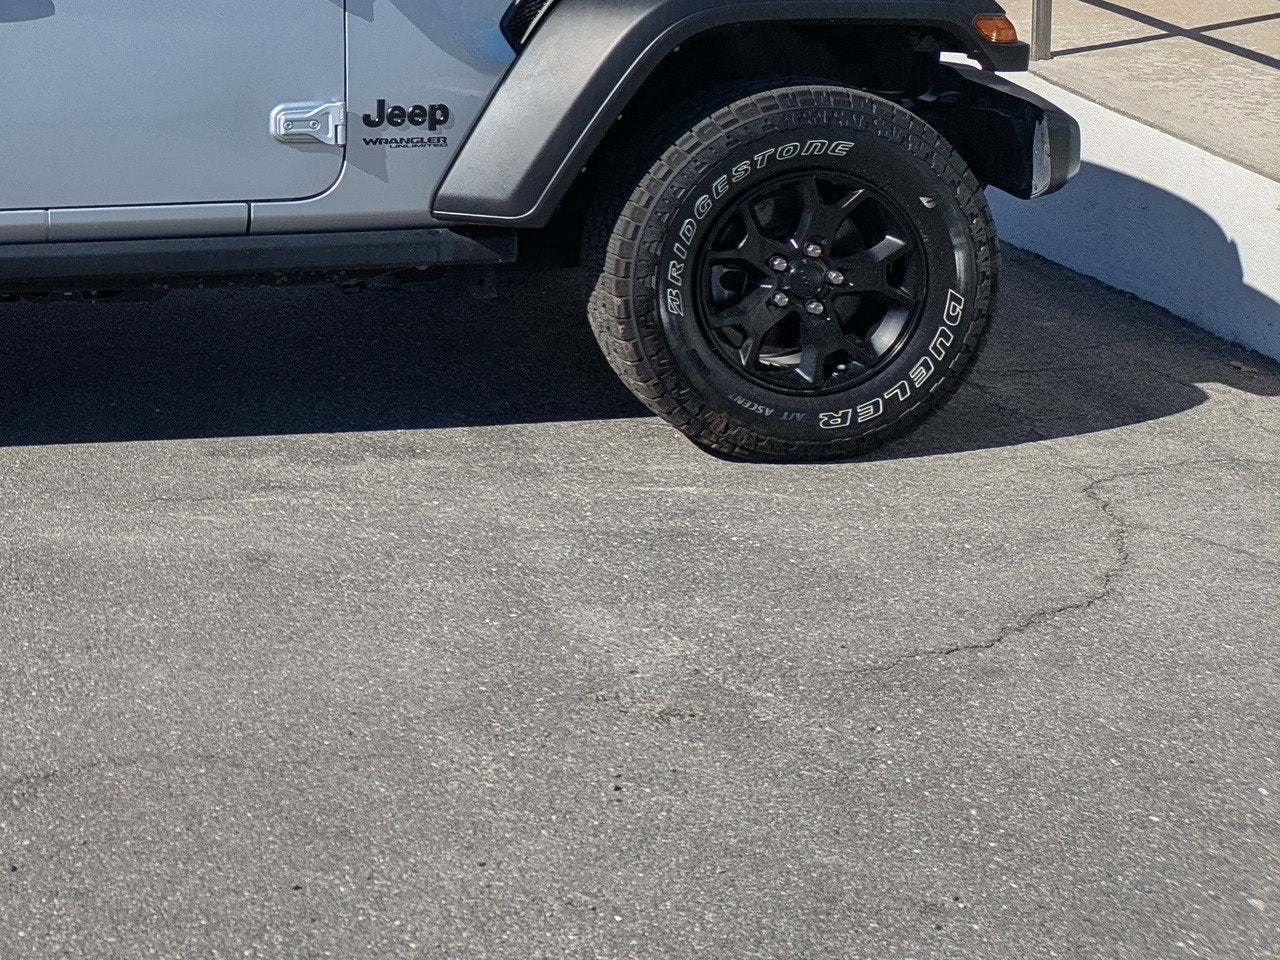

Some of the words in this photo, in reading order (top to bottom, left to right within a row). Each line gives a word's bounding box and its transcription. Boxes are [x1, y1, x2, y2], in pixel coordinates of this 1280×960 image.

[362, 98, 450, 131] Jeep
[362, 136, 448, 146] WRANGLER
[666, 139, 855, 317] BRIDGESTONE
[819, 288, 965, 429] DUELER
[726, 392, 775, 416] ASCENT
